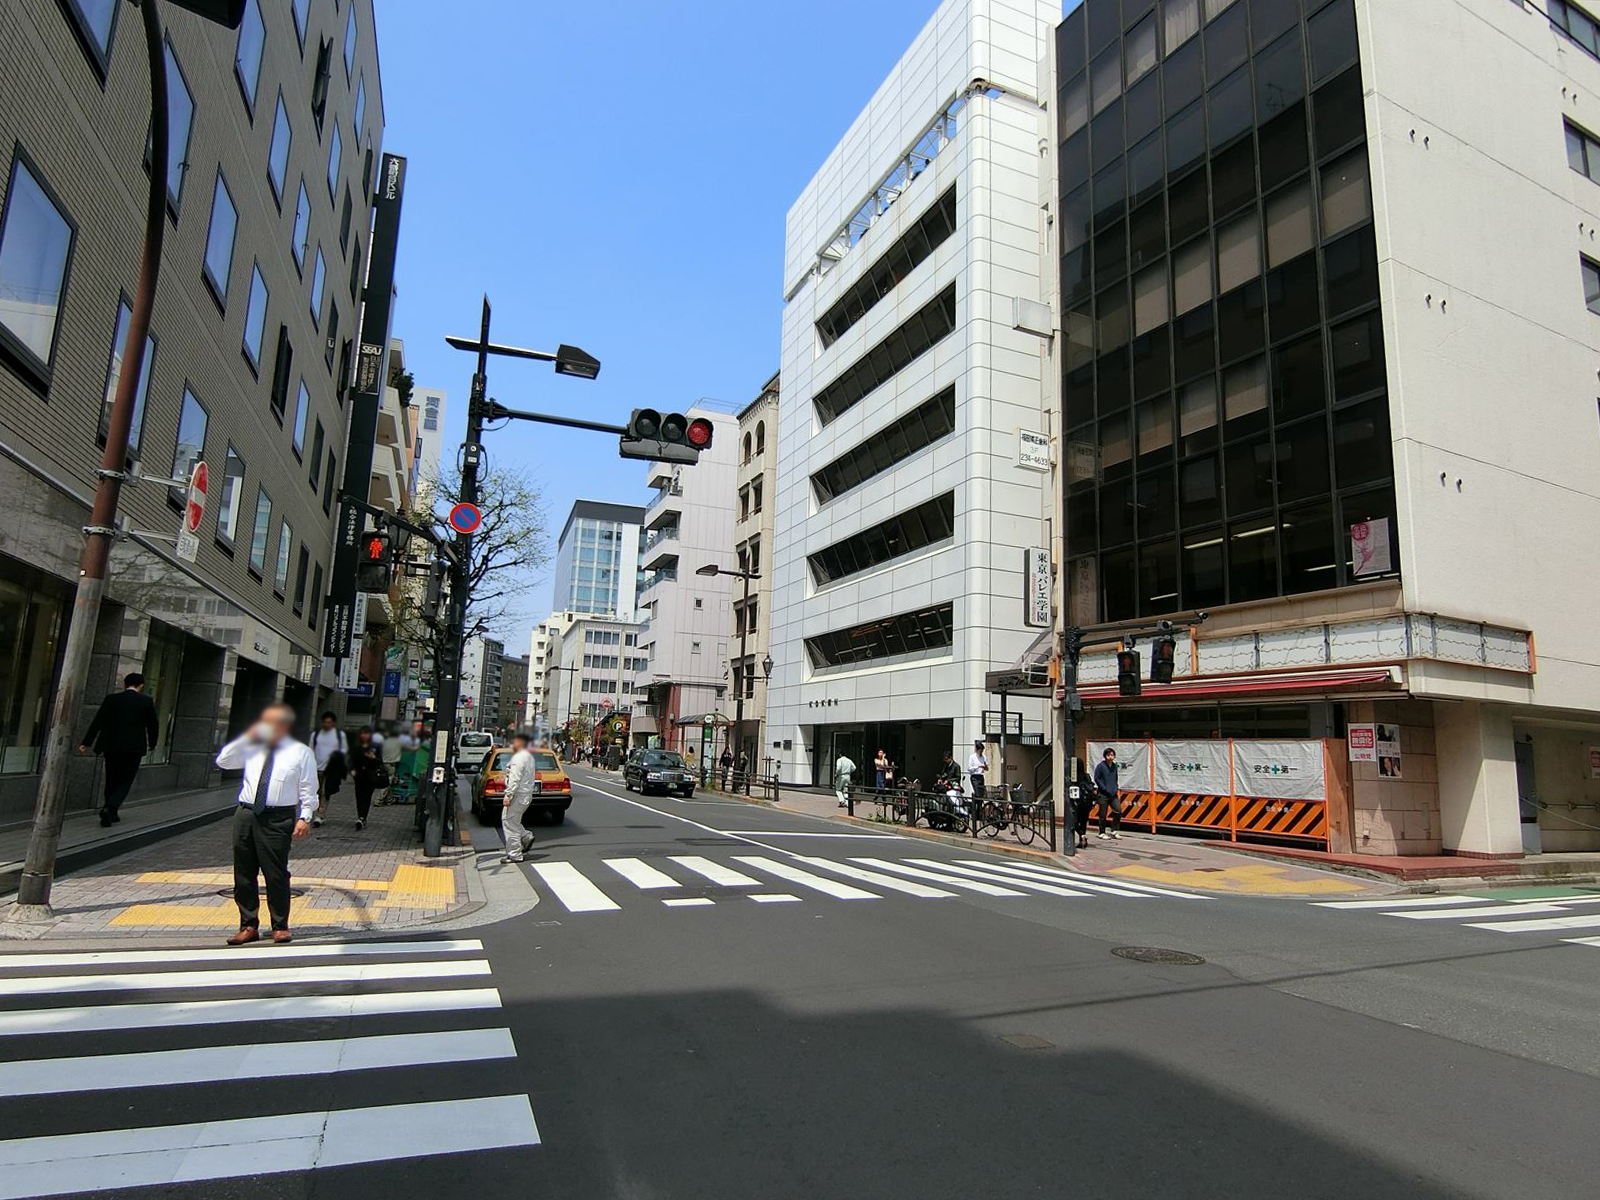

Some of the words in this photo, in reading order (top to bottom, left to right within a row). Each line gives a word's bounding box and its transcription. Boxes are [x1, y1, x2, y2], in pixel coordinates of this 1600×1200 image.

[361, 345, 382, 356] SEAJ
[1037, 552, 1048, 623] 東京バレエ学園
